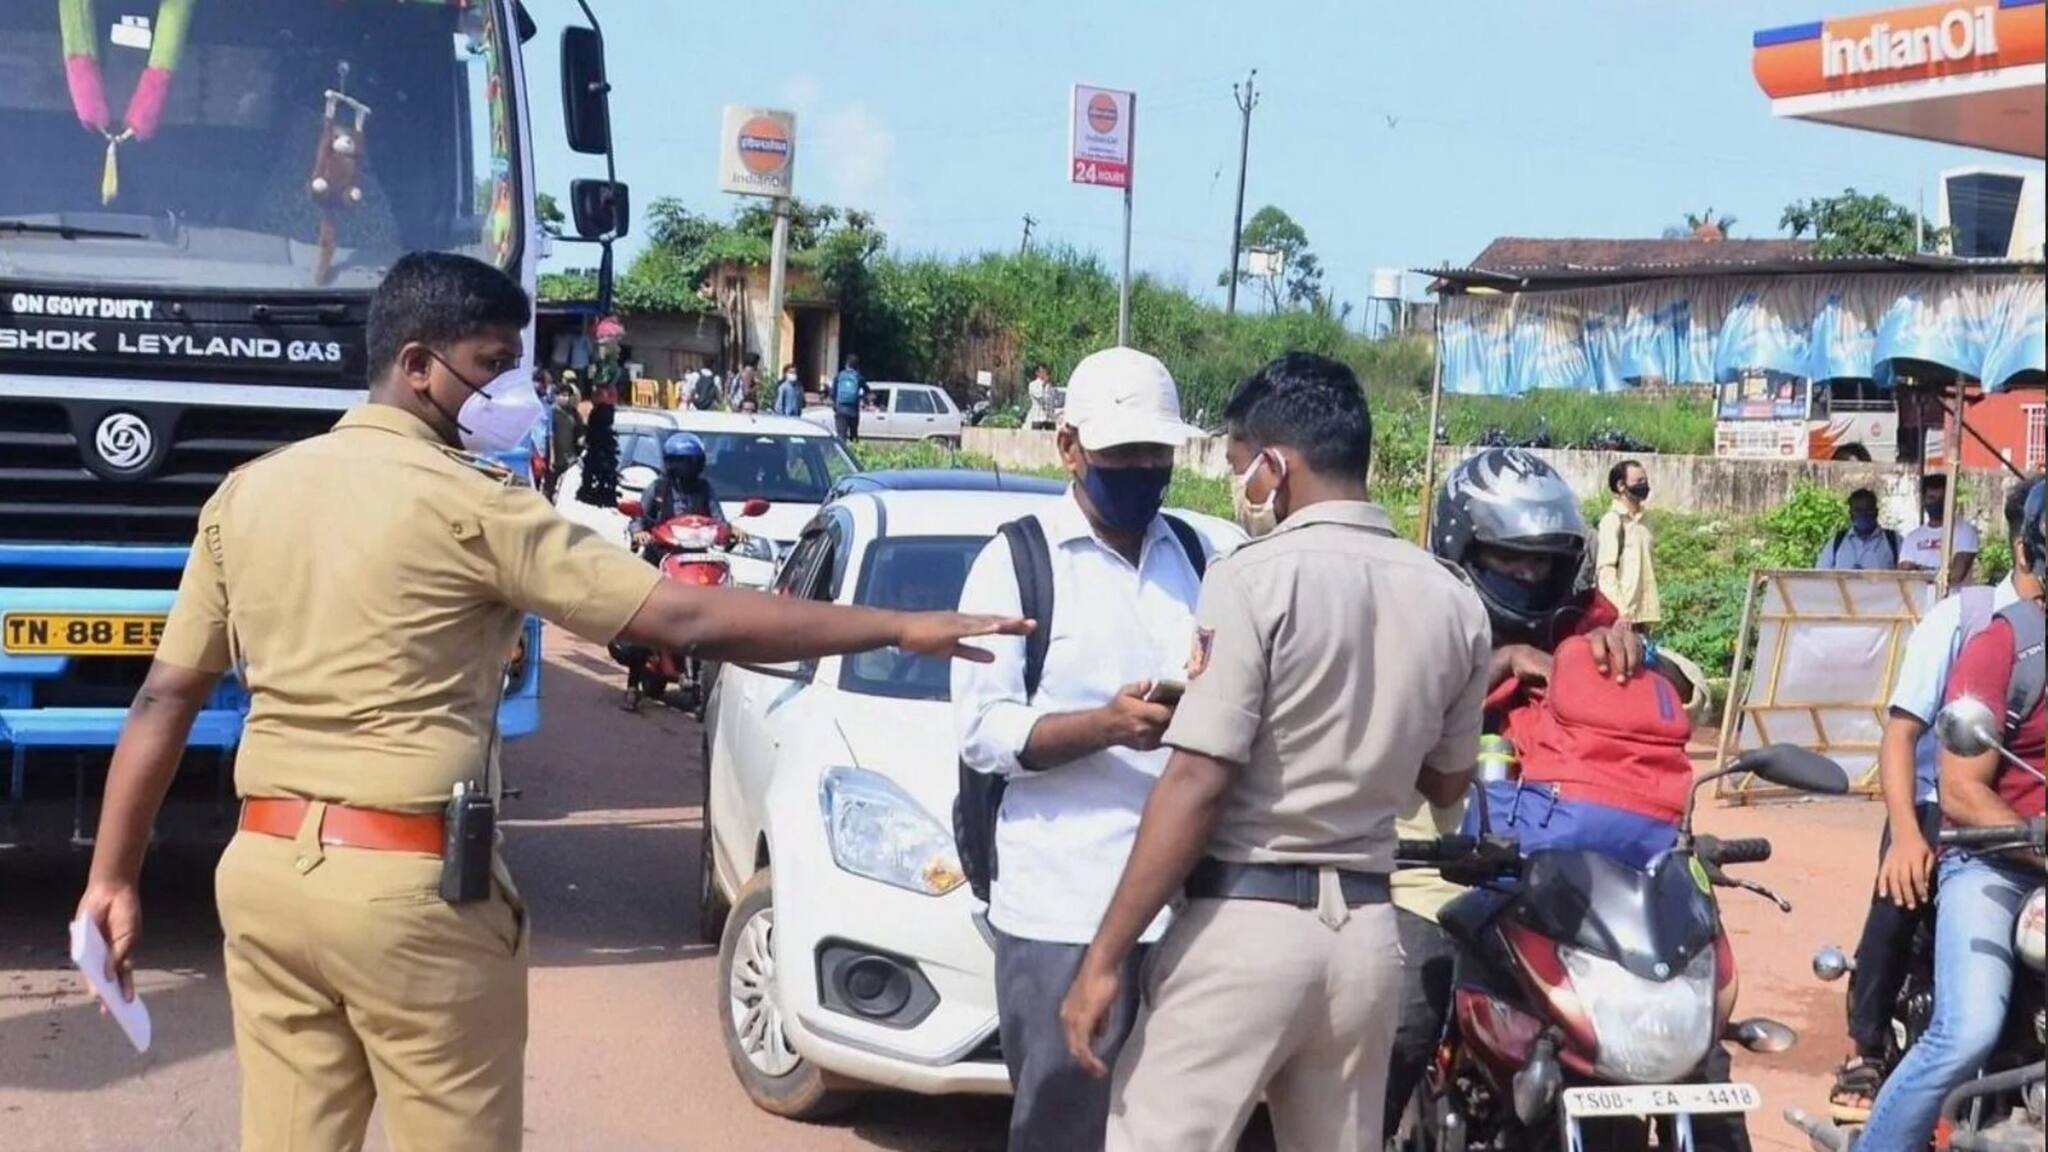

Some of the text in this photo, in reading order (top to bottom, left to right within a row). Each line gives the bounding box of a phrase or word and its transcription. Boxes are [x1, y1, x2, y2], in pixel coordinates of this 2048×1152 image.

[1822, 6, 1998, 77] IndianOil
[1076, 162, 1097, 182] 24
[12, 293, 153, 319] ON GOVT DUTY
[118, 333, 281, 358] LEYLAND
[287, 341, 341, 361] GAS
[9, 620, 48, 644] TN
[66, 621, 112, 644] 88
